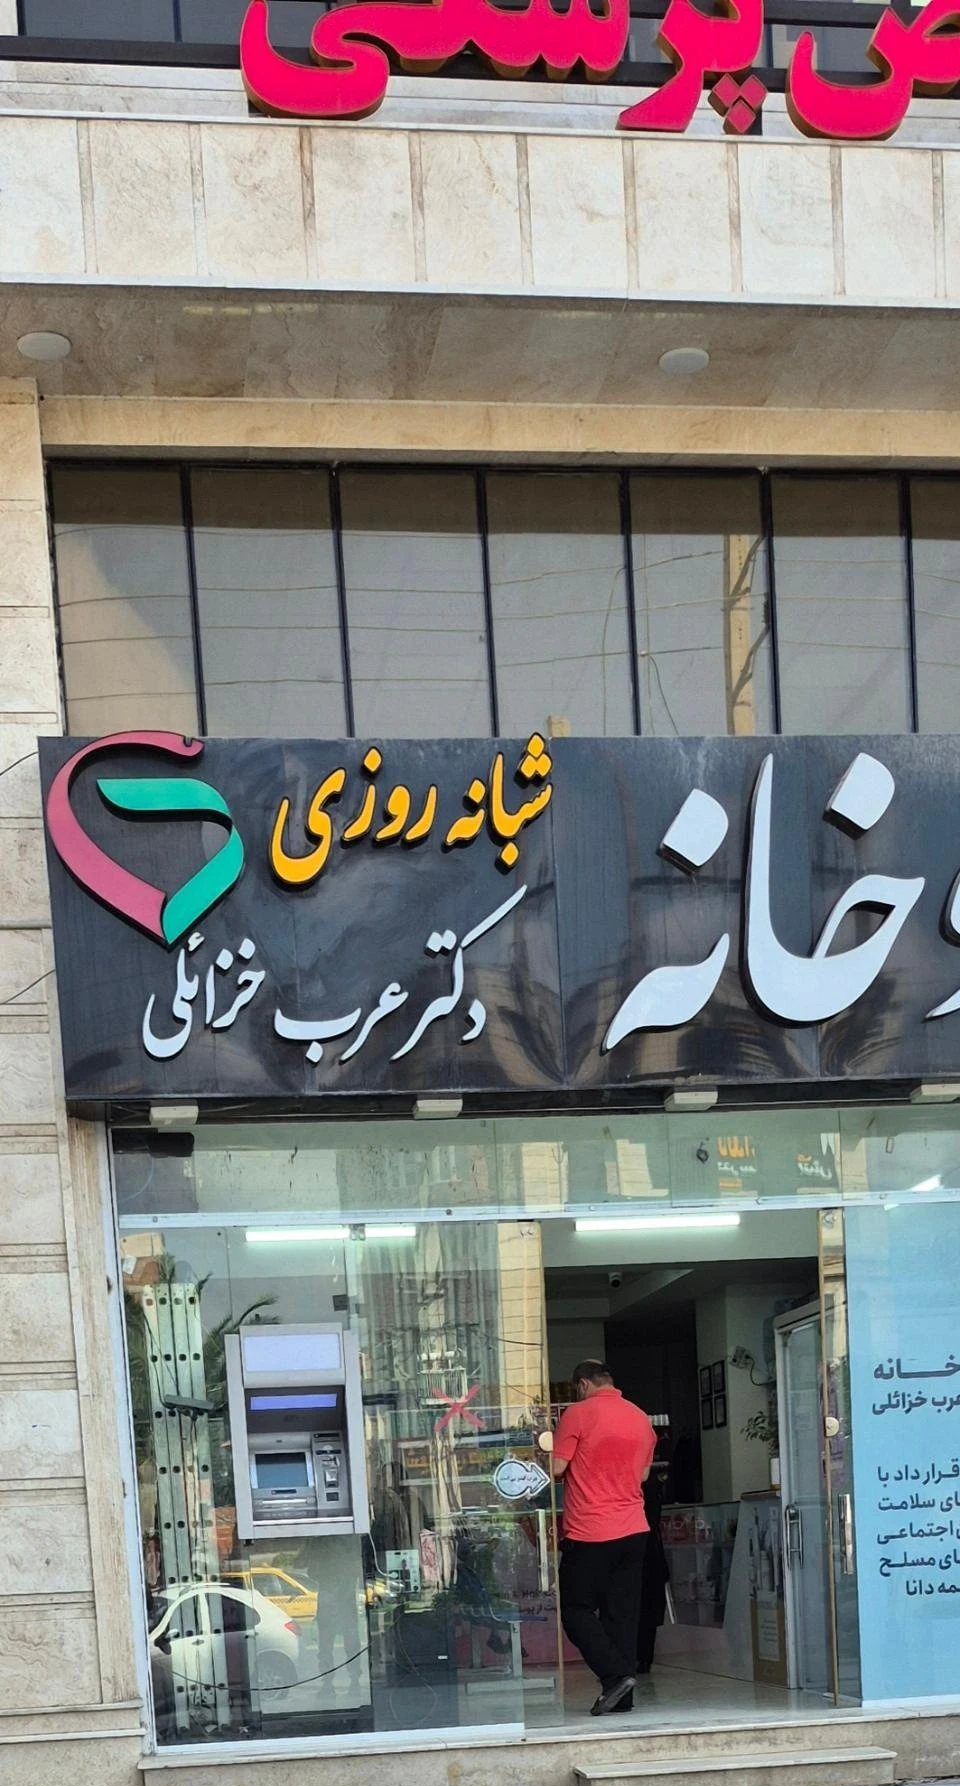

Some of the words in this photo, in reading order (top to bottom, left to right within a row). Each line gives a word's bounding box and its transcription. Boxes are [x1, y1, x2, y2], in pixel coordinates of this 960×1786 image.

[444, 733, 554, 869] شبانه
[270, 747, 438, 886] روزی
[391, 885, 528, 1061] دکتر
[143, 932, 267, 1060] خزائلی
[274, 982, 409, 1064] عرب
[872, 1390, 928, 1415] خزائلی
[877, 1466, 889, 1488] با
[878, 1493, 936, 1511] سلامت
[877, 1520, 953, 1545] اجتماعی
[879, 1551, 936, 1577] مسلح
[906, 1580, 934, 1596] دانا
